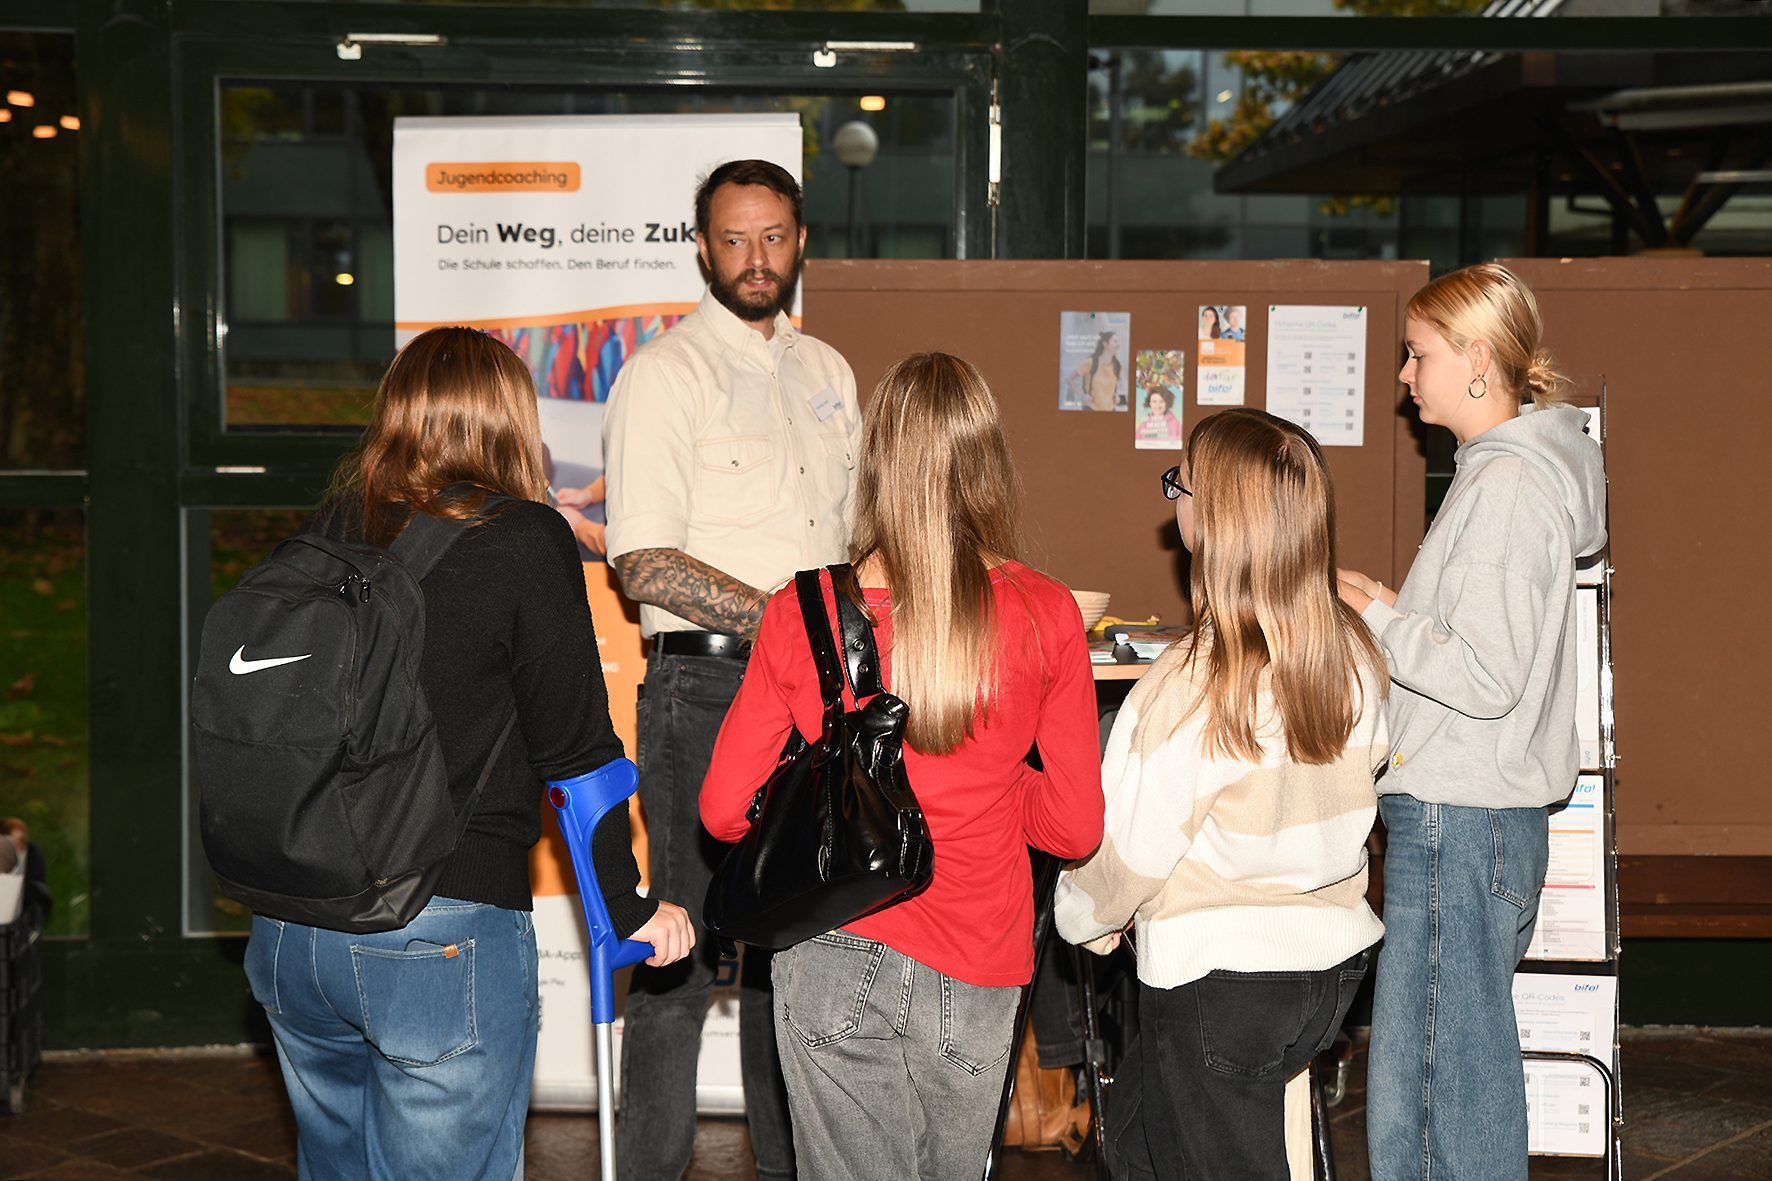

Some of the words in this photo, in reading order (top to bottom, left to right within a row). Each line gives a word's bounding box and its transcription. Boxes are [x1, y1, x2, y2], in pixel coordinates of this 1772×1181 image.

[437, 170, 568, 188] Jugendcoaching
[437, 222, 489, 244] Dein
[496, 222, 563, 249] Weg,
[570, 222, 635, 243] deine
[438, 259, 458, 270] Die
[462, 259, 501, 270] Schule
[506, 259, 562, 270] schaffen.
[567, 259, 592, 270] Den
[596, 259, 629, 270] Beruf
[634, 259, 676, 270] finden.
[1574, 784, 1596, 793] ifo!
[1573, 984, 1601, 992] bifo!
